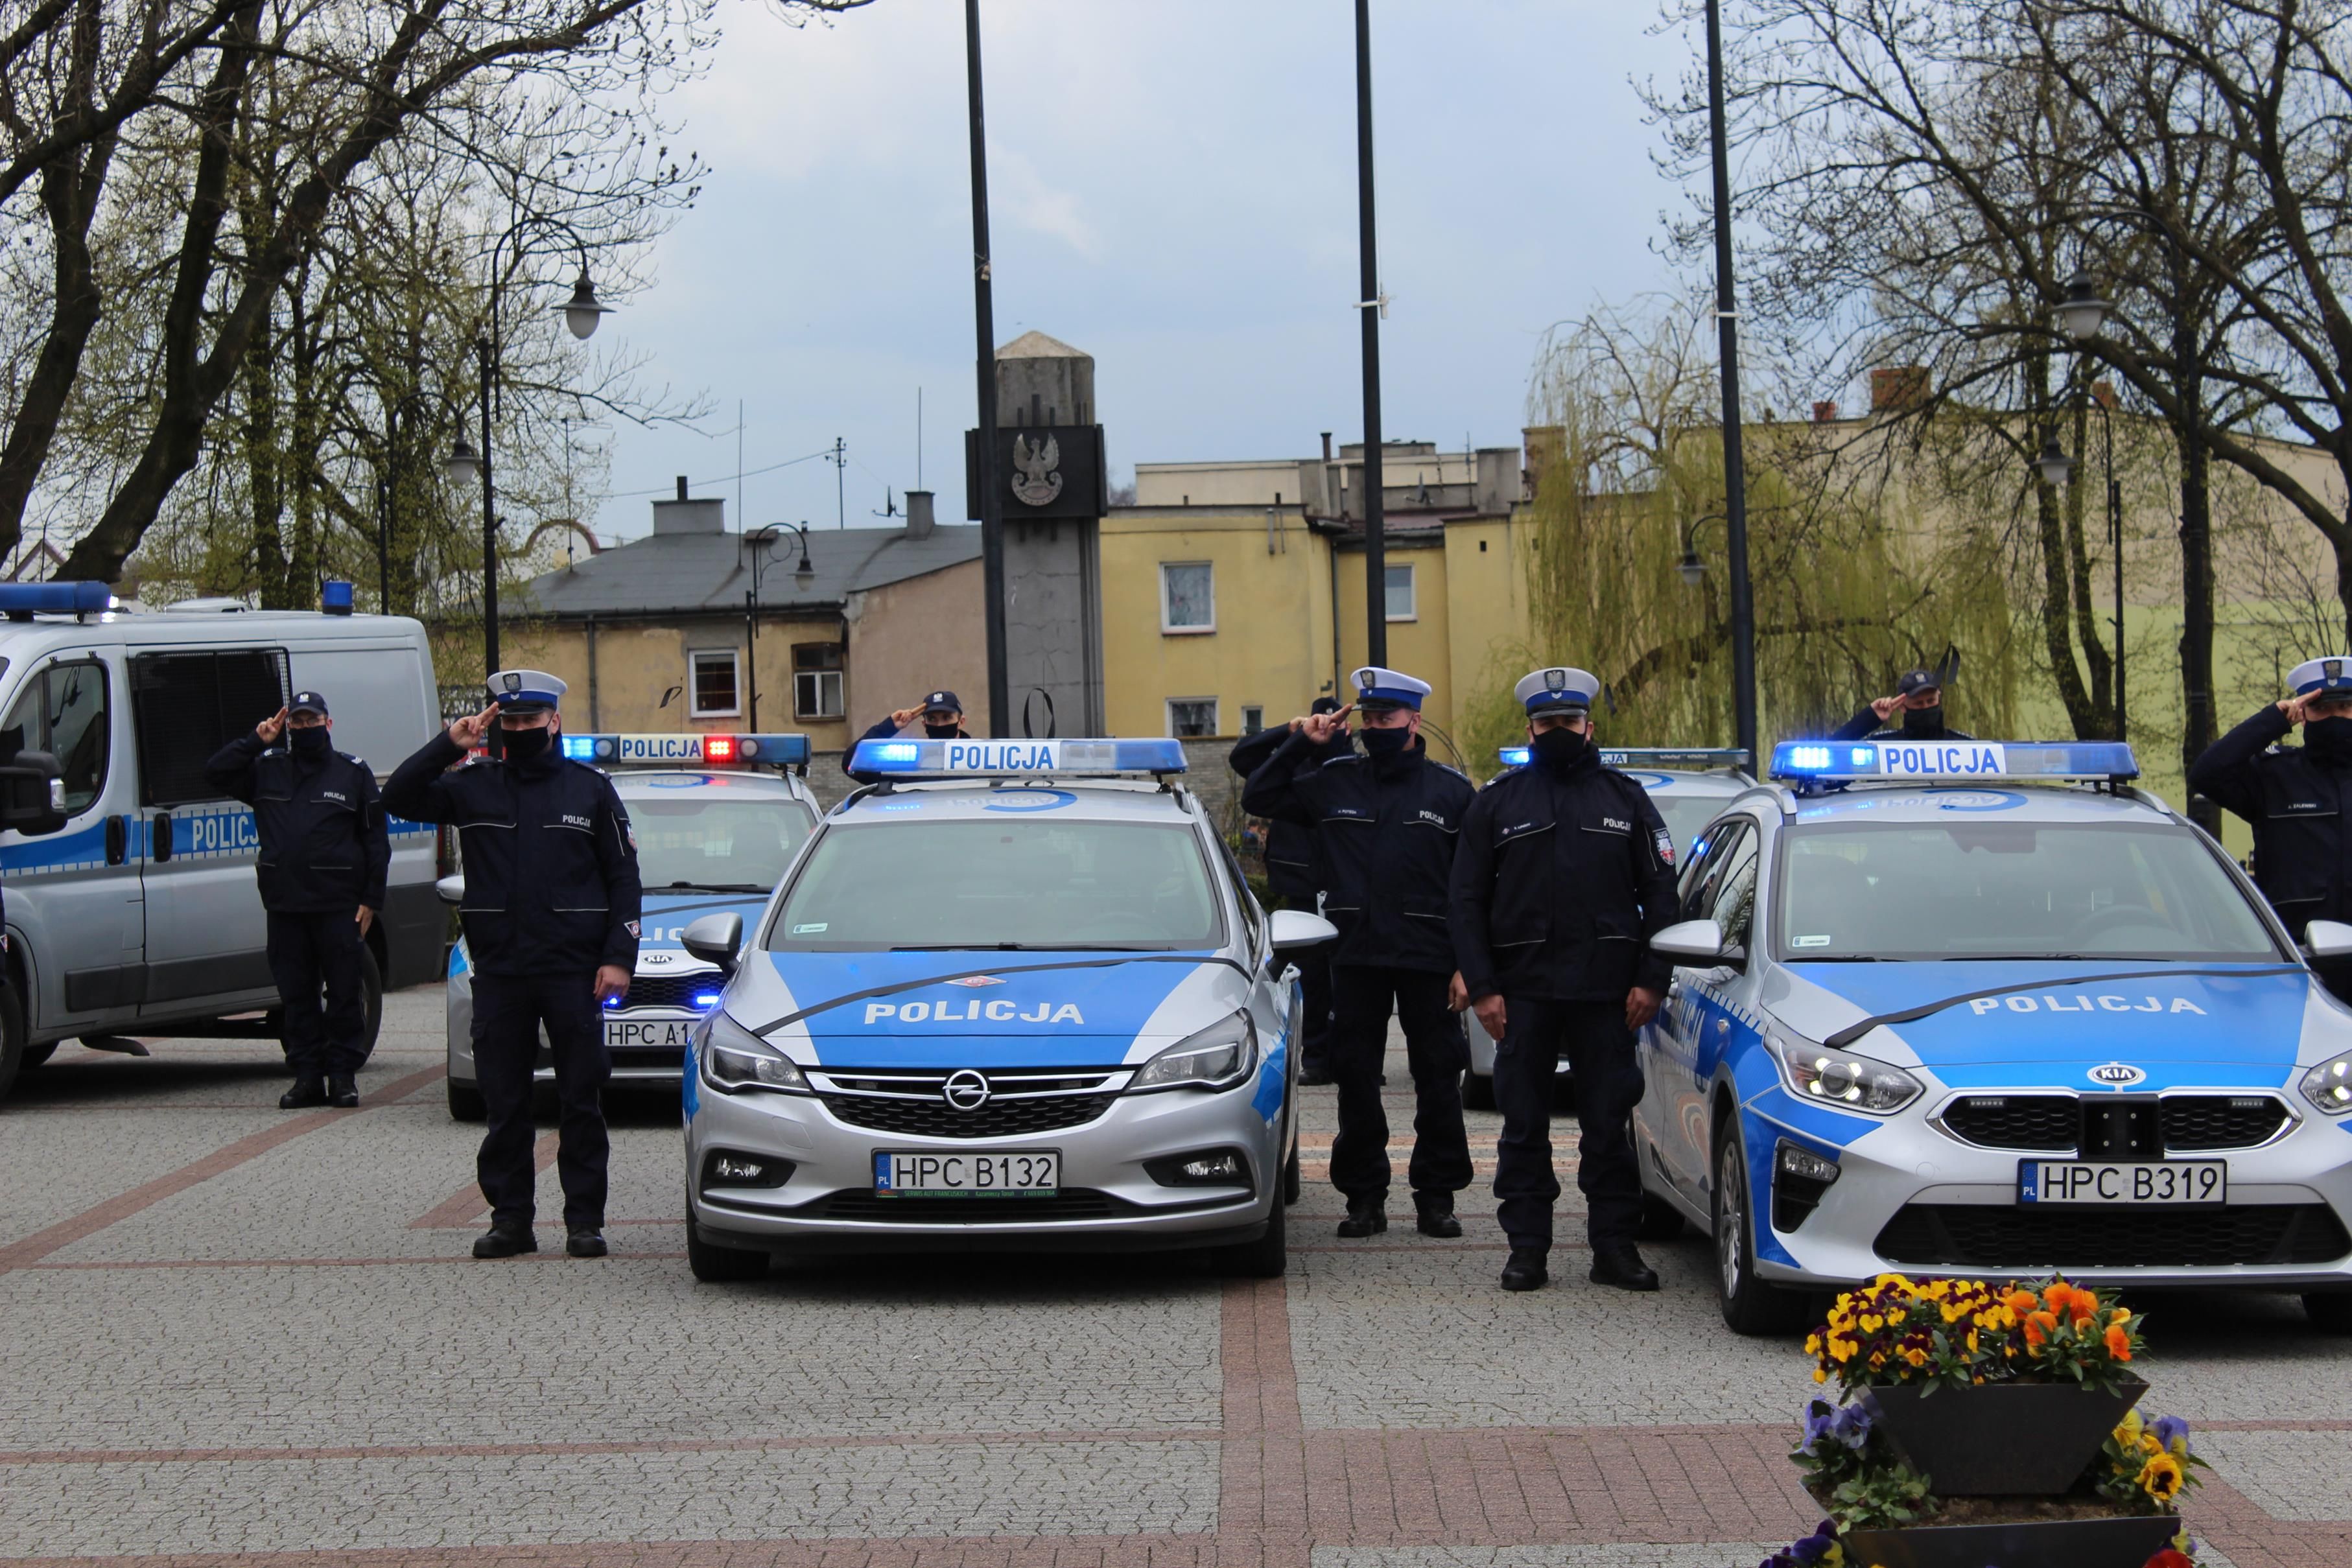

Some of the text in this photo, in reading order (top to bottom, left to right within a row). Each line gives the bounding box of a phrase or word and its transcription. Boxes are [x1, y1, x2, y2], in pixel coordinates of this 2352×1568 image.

[622, 740, 701, 757] POLICJA
[950, 746, 1054, 769] POLICJA
[1885, 748, 2000, 773] POLICJA
[323, 791, 346, 801] POLICJA
[563, 815, 591, 828] POLICJA
[1419, 810, 1444, 825] POLICJA
[864, 1000, 1085, 1025] POLICJA
[1968, 995, 2208, 1015] POLICJA
[608, 1023, 688, 1045] HPC A1
[2100, 1068, 2133, 1079] KIA
[878, 1157, 1052, 1187] PL HPC B132
[2023, 1167, 2217, 1200] PL HPC B319
